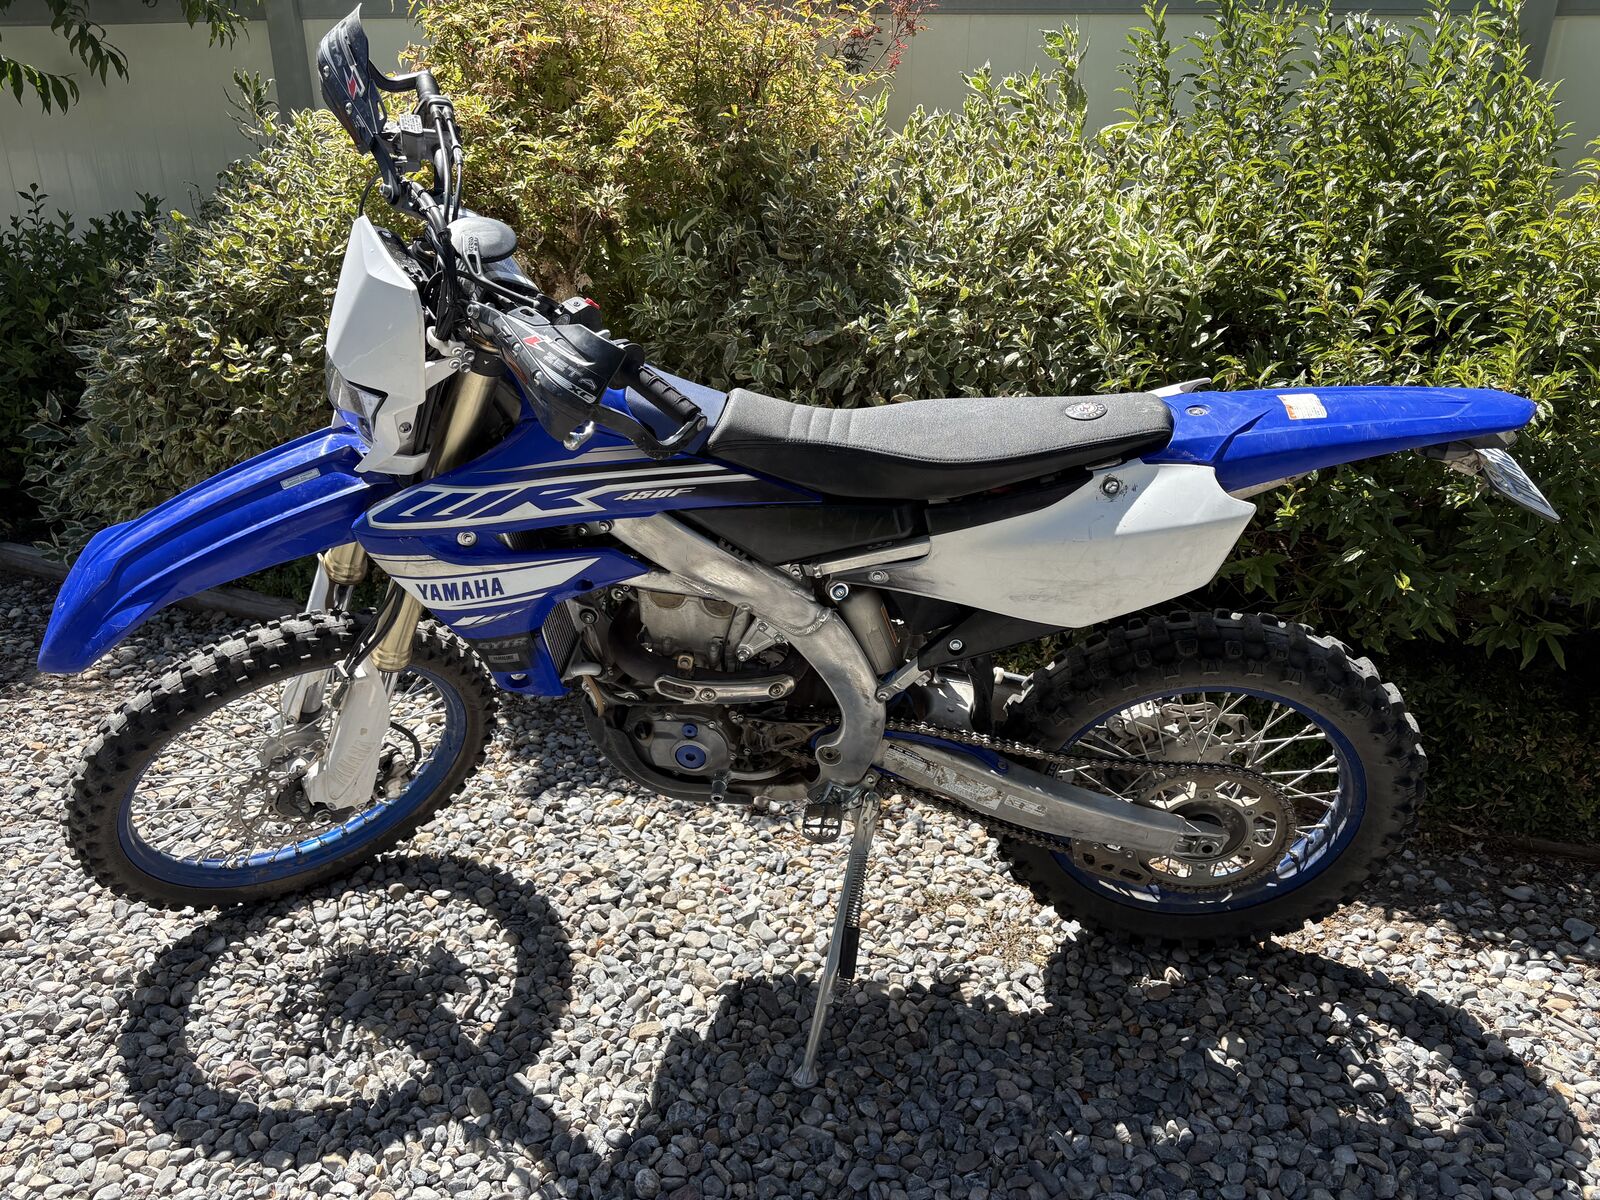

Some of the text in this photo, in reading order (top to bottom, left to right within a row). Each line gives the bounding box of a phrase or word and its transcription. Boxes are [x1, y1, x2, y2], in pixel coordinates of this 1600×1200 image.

[543, 351, 598, 391] ZETA
[568, 384, 594, 401] XC
[613, 486, 697, 501] 450F
[415, 577, 505, 602] YAMAHA
